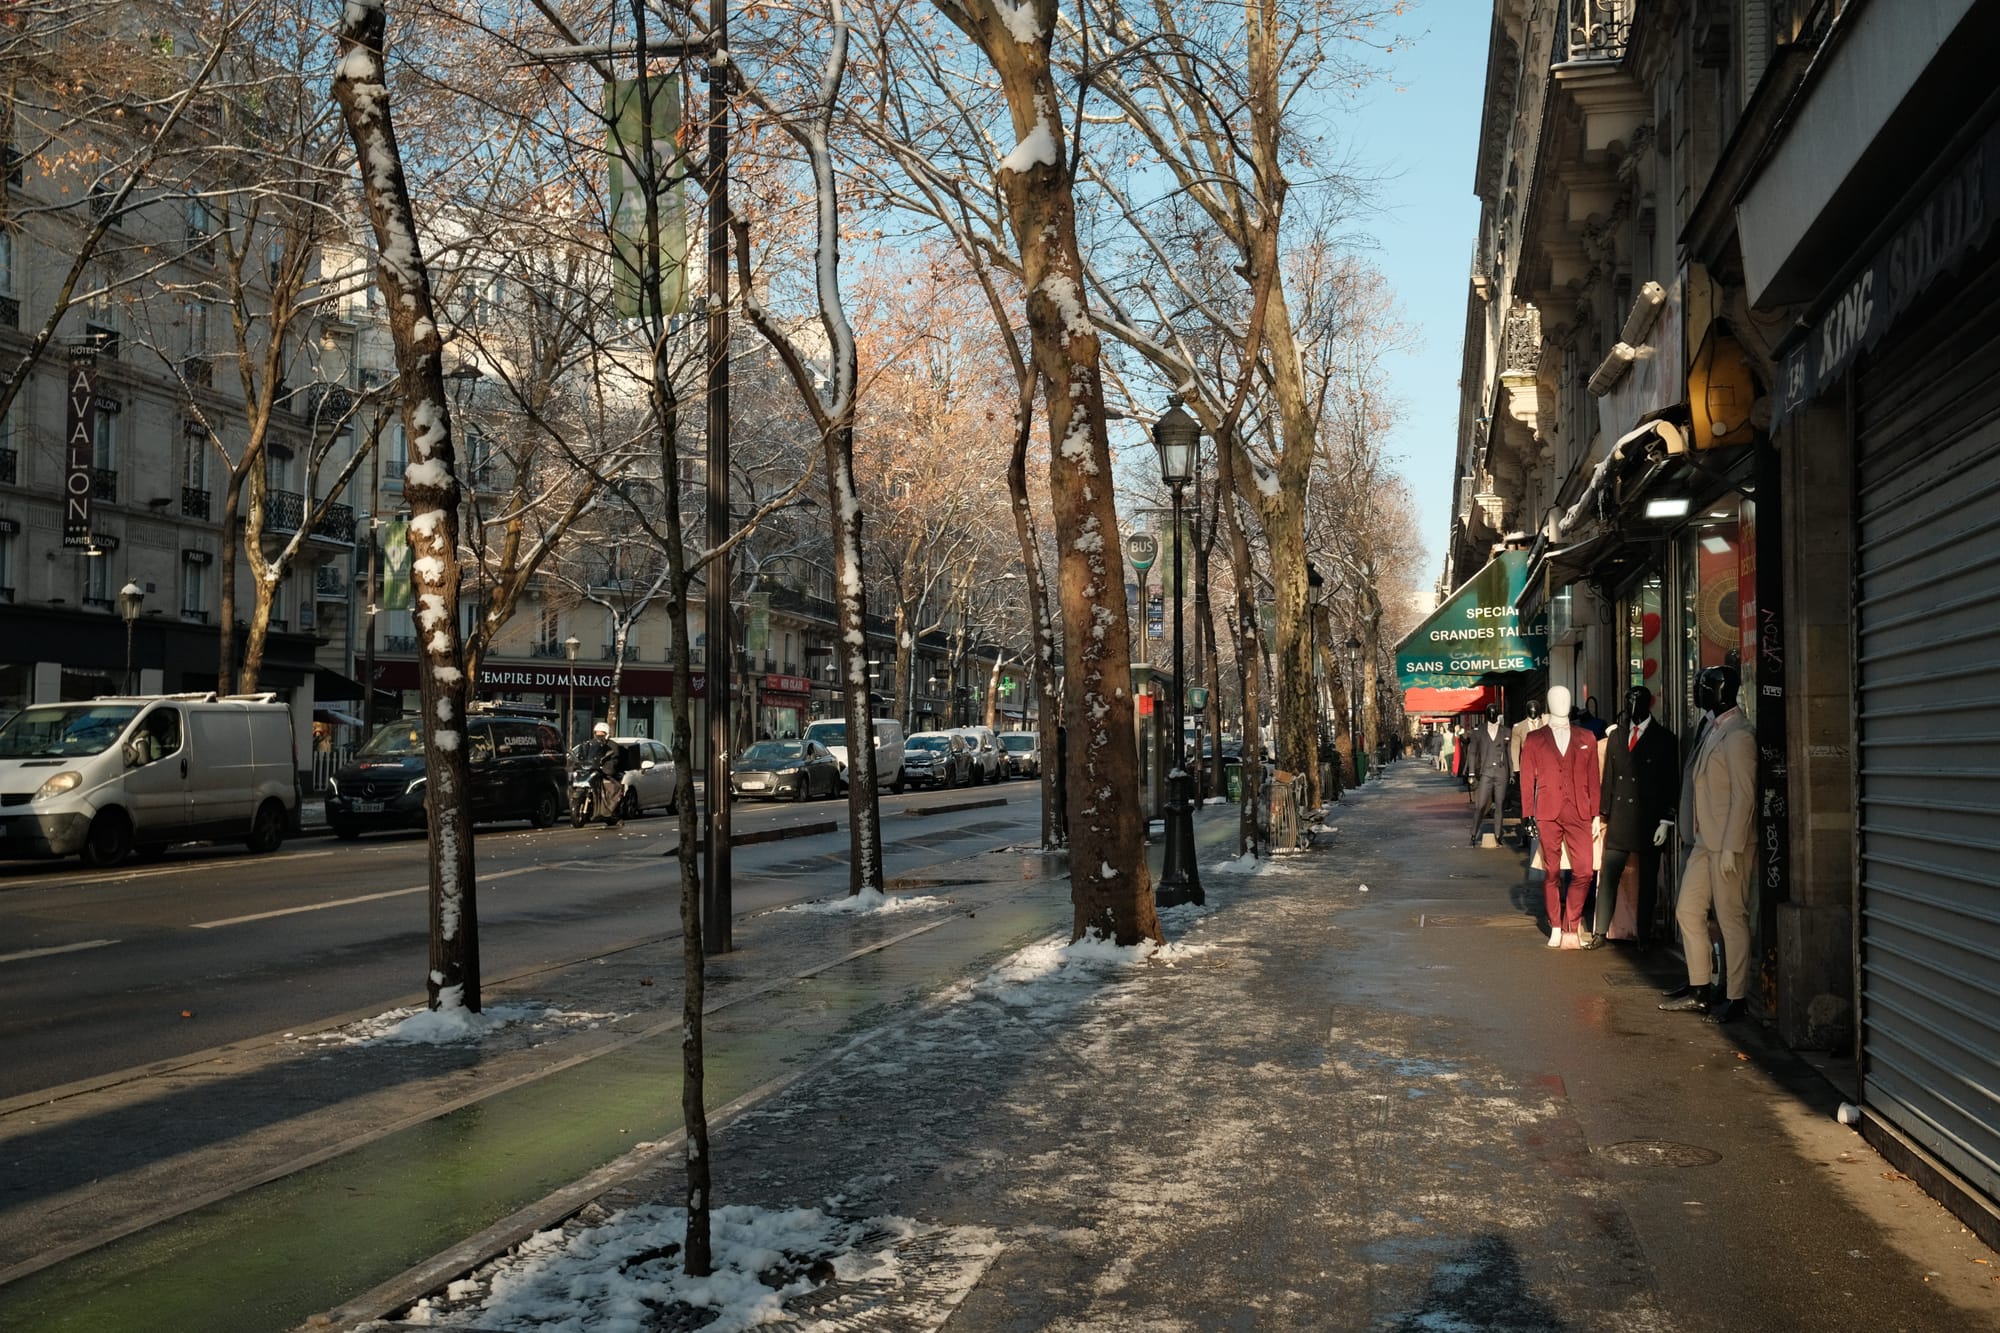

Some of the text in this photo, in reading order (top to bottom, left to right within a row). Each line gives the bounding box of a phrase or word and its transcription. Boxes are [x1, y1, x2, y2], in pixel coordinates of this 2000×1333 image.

[1818, 267, 1874, 380] KING
[67, 371, 91, 520] AVALON
[1131, 541, 1153, 553] BUS
[1430, 627, 1495, 641] GRANDES
[1406, 660, 1444, 672] SANS
[1450, 657, 1526, 671] COMPLEXE
[536, 674, 556, 687] DU
[557, 675, 611, 688] MARIAG
